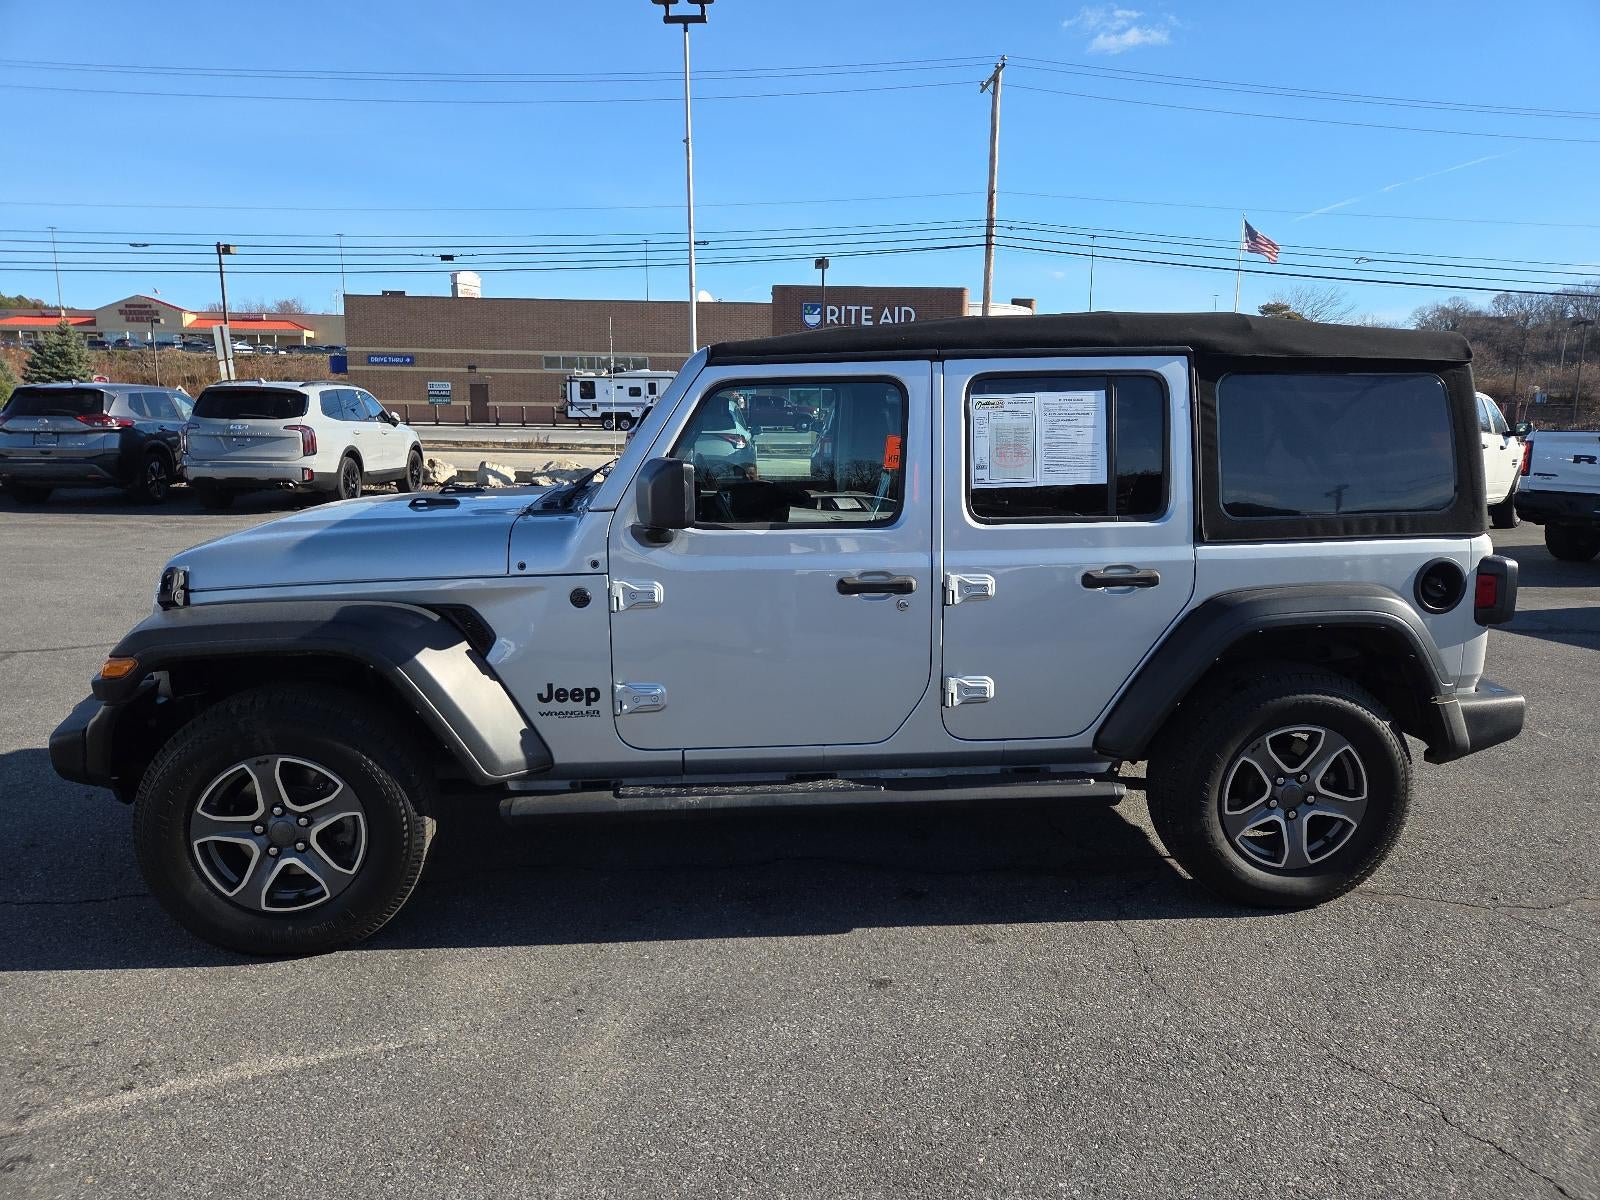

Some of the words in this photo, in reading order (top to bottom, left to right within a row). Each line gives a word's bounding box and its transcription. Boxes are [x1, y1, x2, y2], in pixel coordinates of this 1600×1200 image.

[826, 305, 874, 326] RITE
[879, 306, 916, 324] AID
[537, 682, 601, 707] Jeep
[538, 709, 600, 717] WRANGLER
